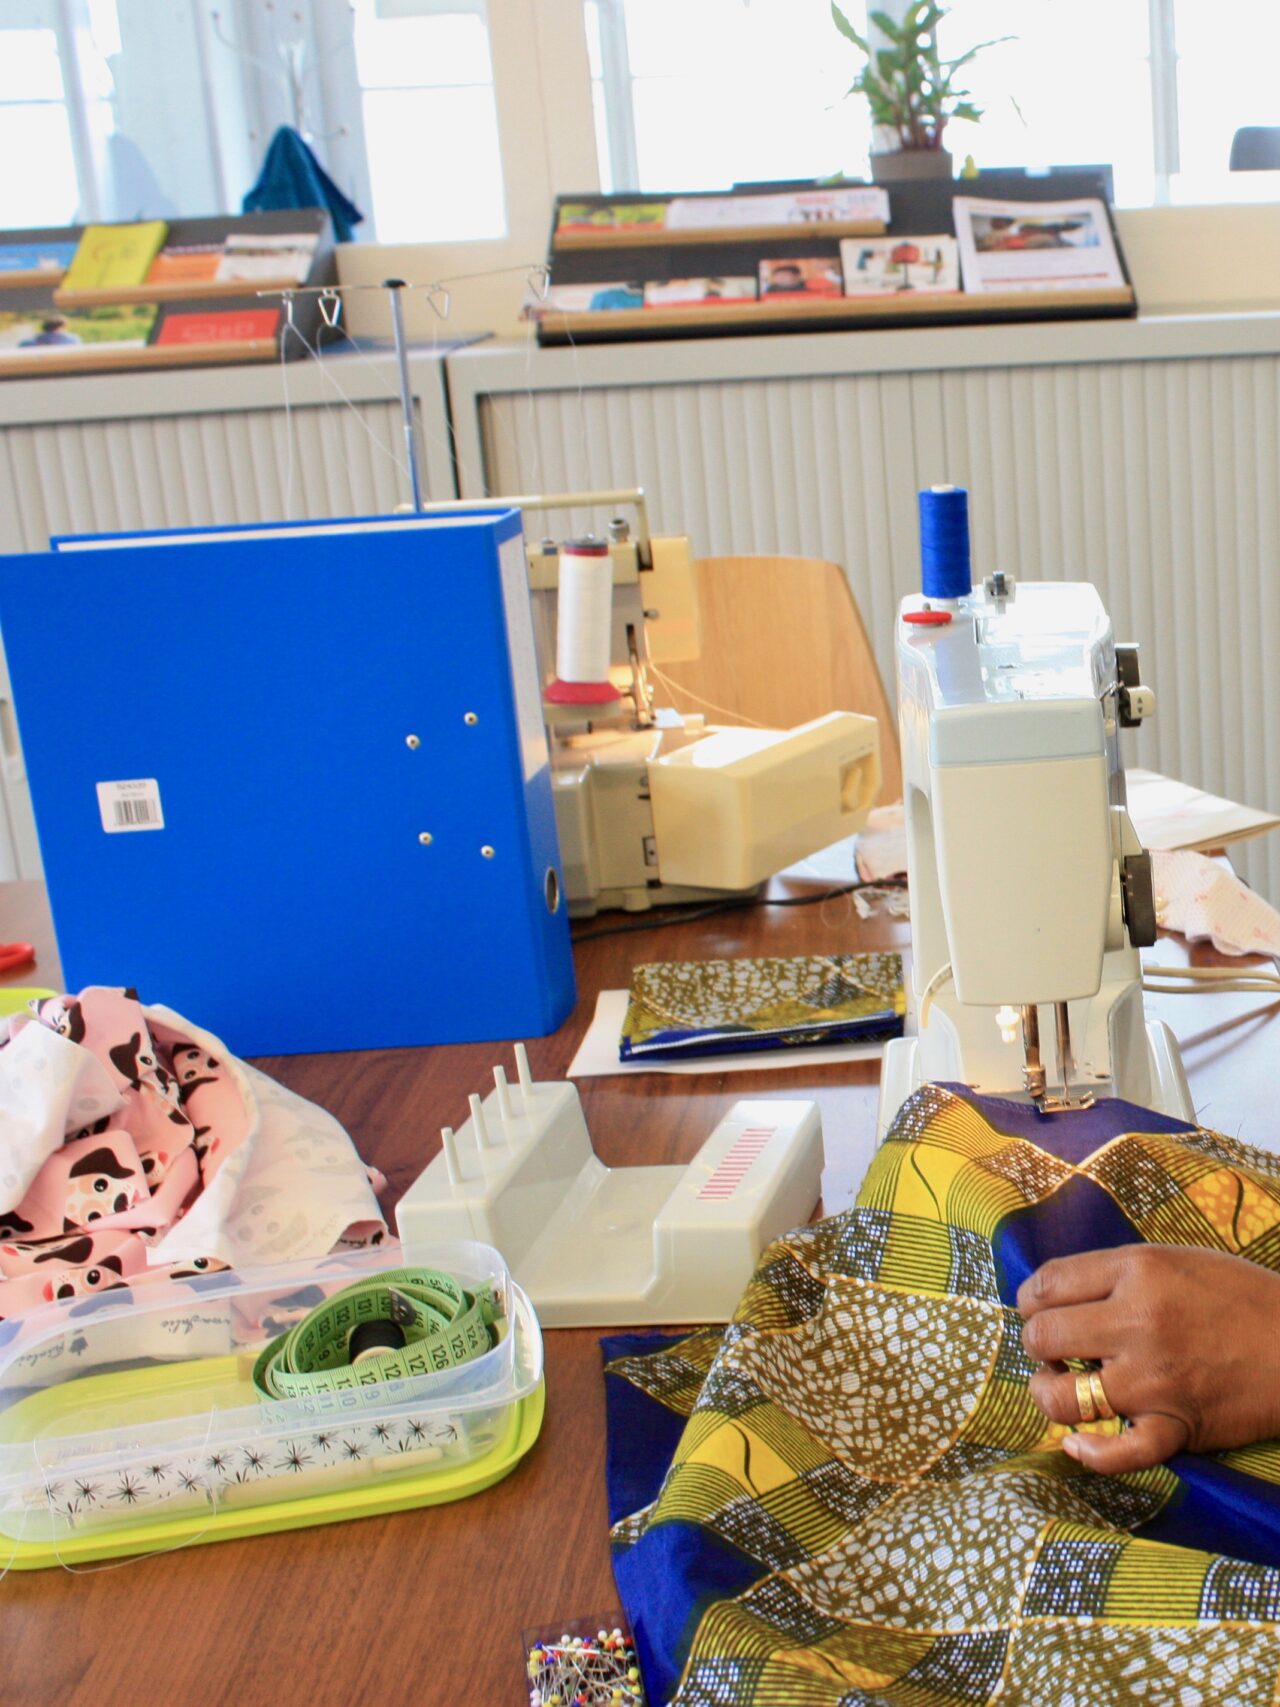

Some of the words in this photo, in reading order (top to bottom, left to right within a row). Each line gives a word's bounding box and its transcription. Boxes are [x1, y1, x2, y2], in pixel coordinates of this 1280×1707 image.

[450, 1334, 467, 1360] 125
[466, 1325, 479, 1349] 124
[431, 1344, 450, 1370] 126
